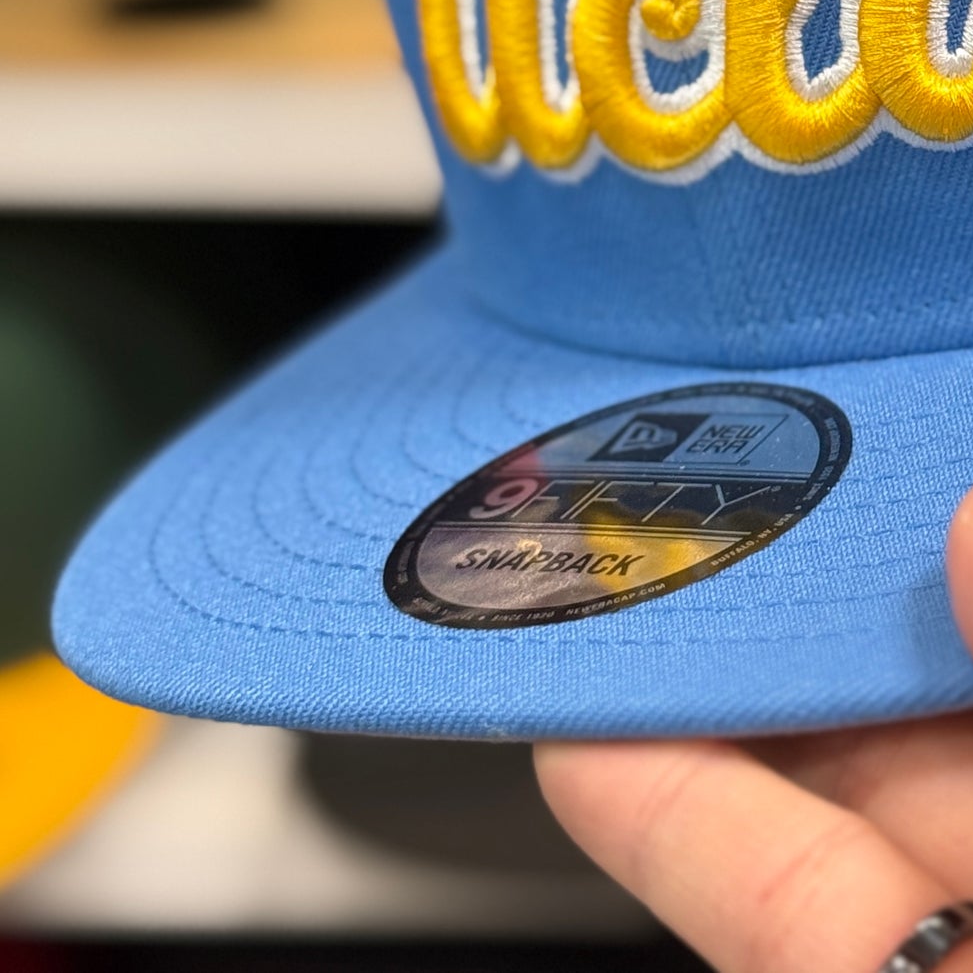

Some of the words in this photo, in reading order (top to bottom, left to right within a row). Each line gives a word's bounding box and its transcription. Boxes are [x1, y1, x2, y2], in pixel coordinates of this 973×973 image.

[701, 424, 766, 439] NEW
[685, 439, 746, 454] ERA
[469, 478, 772, 526] 9FIFTY
[455, 547, 645, 577] SNAPBACK
